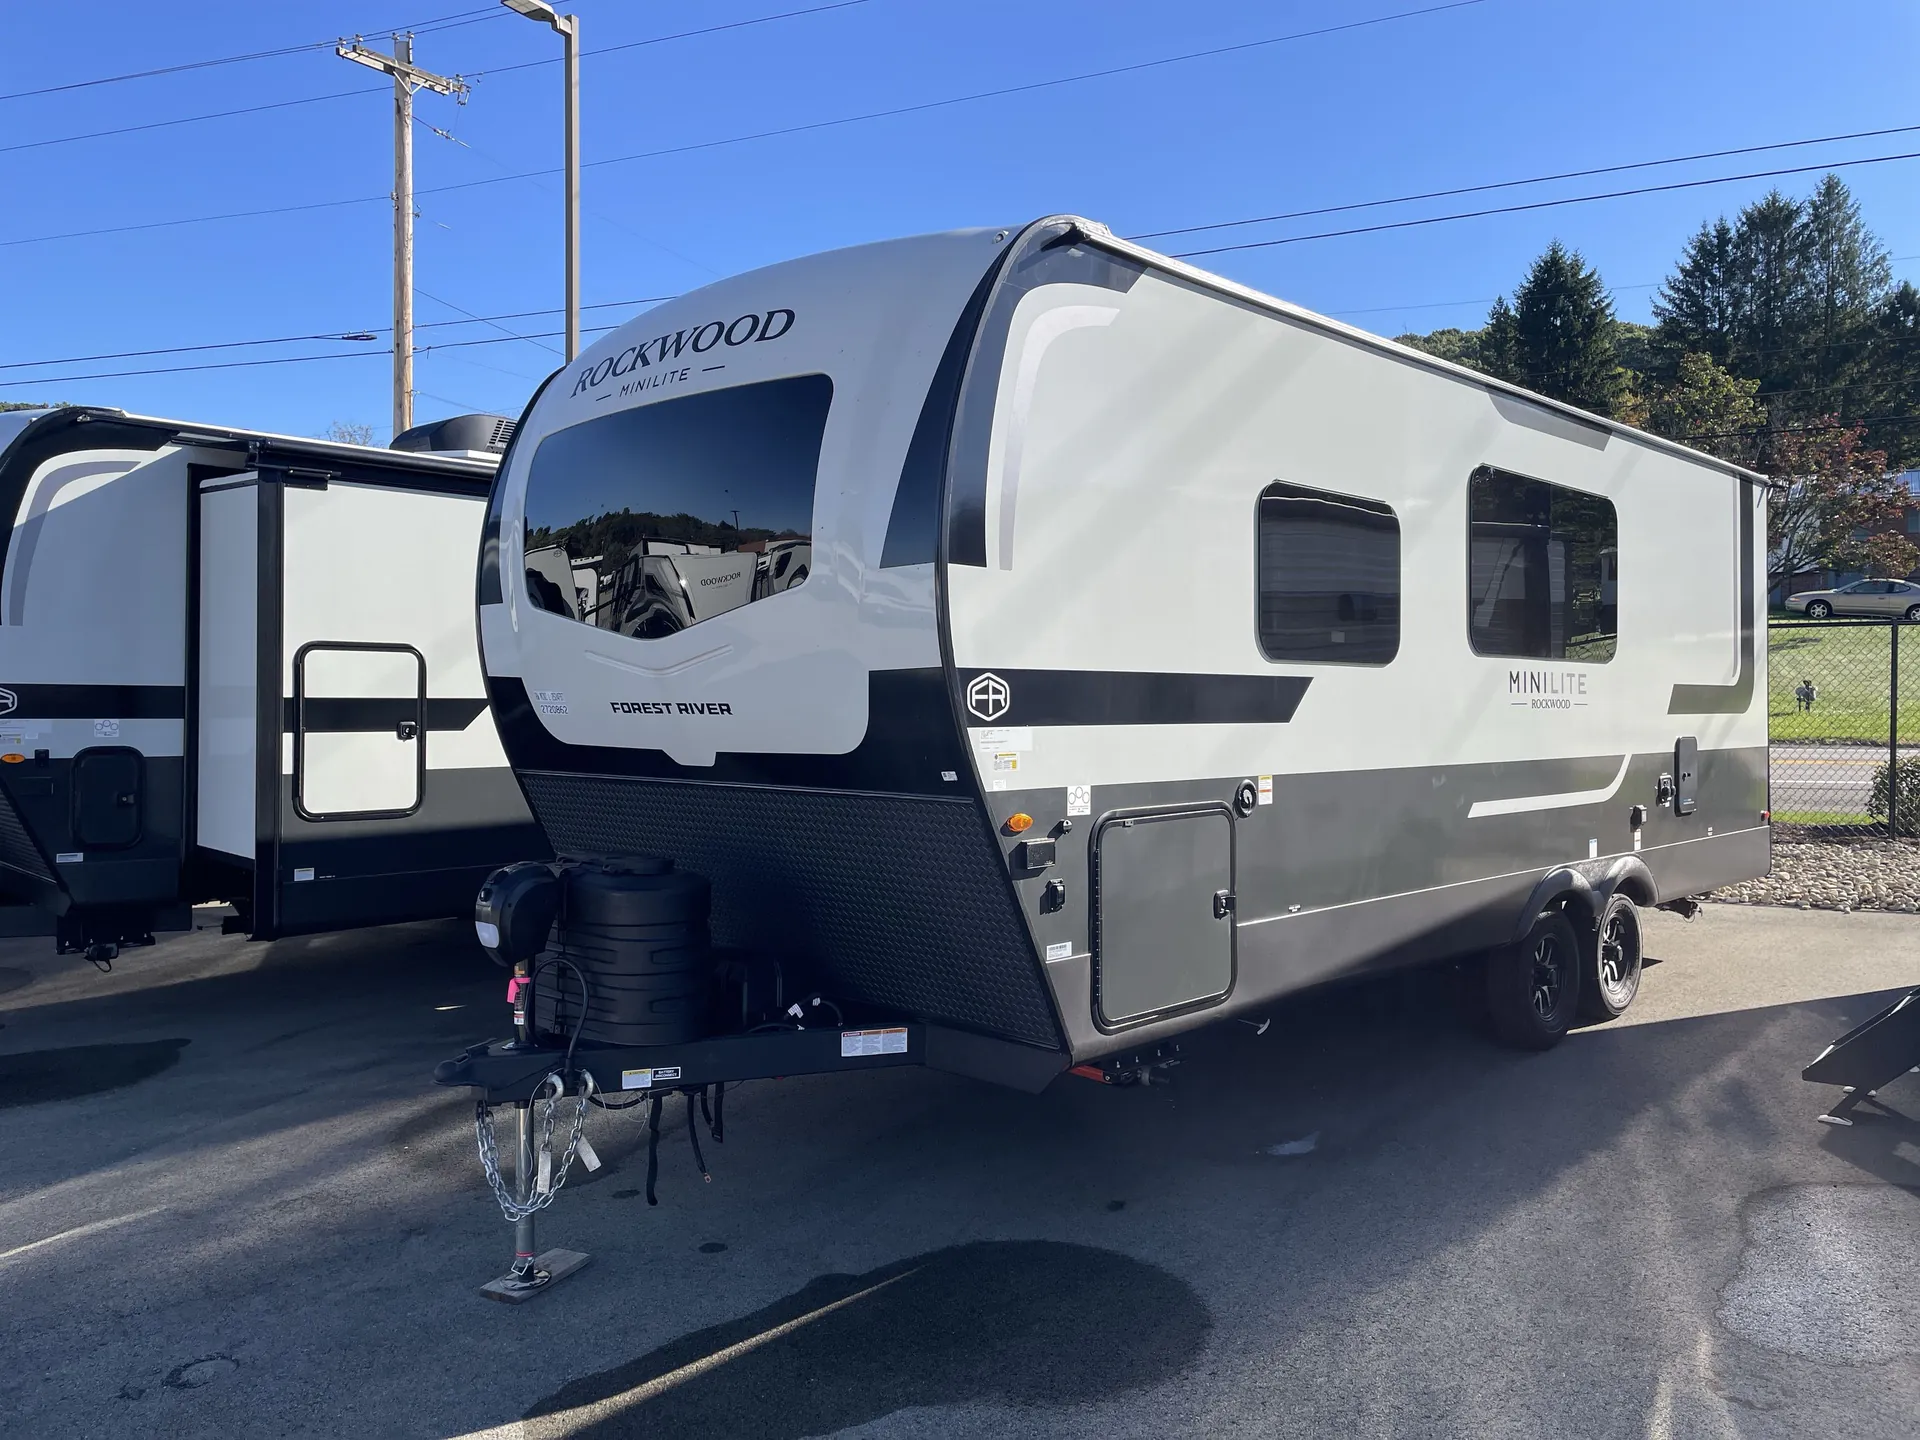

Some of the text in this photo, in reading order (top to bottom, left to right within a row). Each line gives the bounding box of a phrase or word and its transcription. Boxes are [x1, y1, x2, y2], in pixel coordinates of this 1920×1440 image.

[570, 308, 796, 399] ROCKWOOD
[619, 367, 691, 398] MINILITE
[1509, 670, 1587, 694] MINILITE
[609, 702, 733, 716] FOREST RIVER
[1531, 698, 1571, 709] ROCKWOOD
